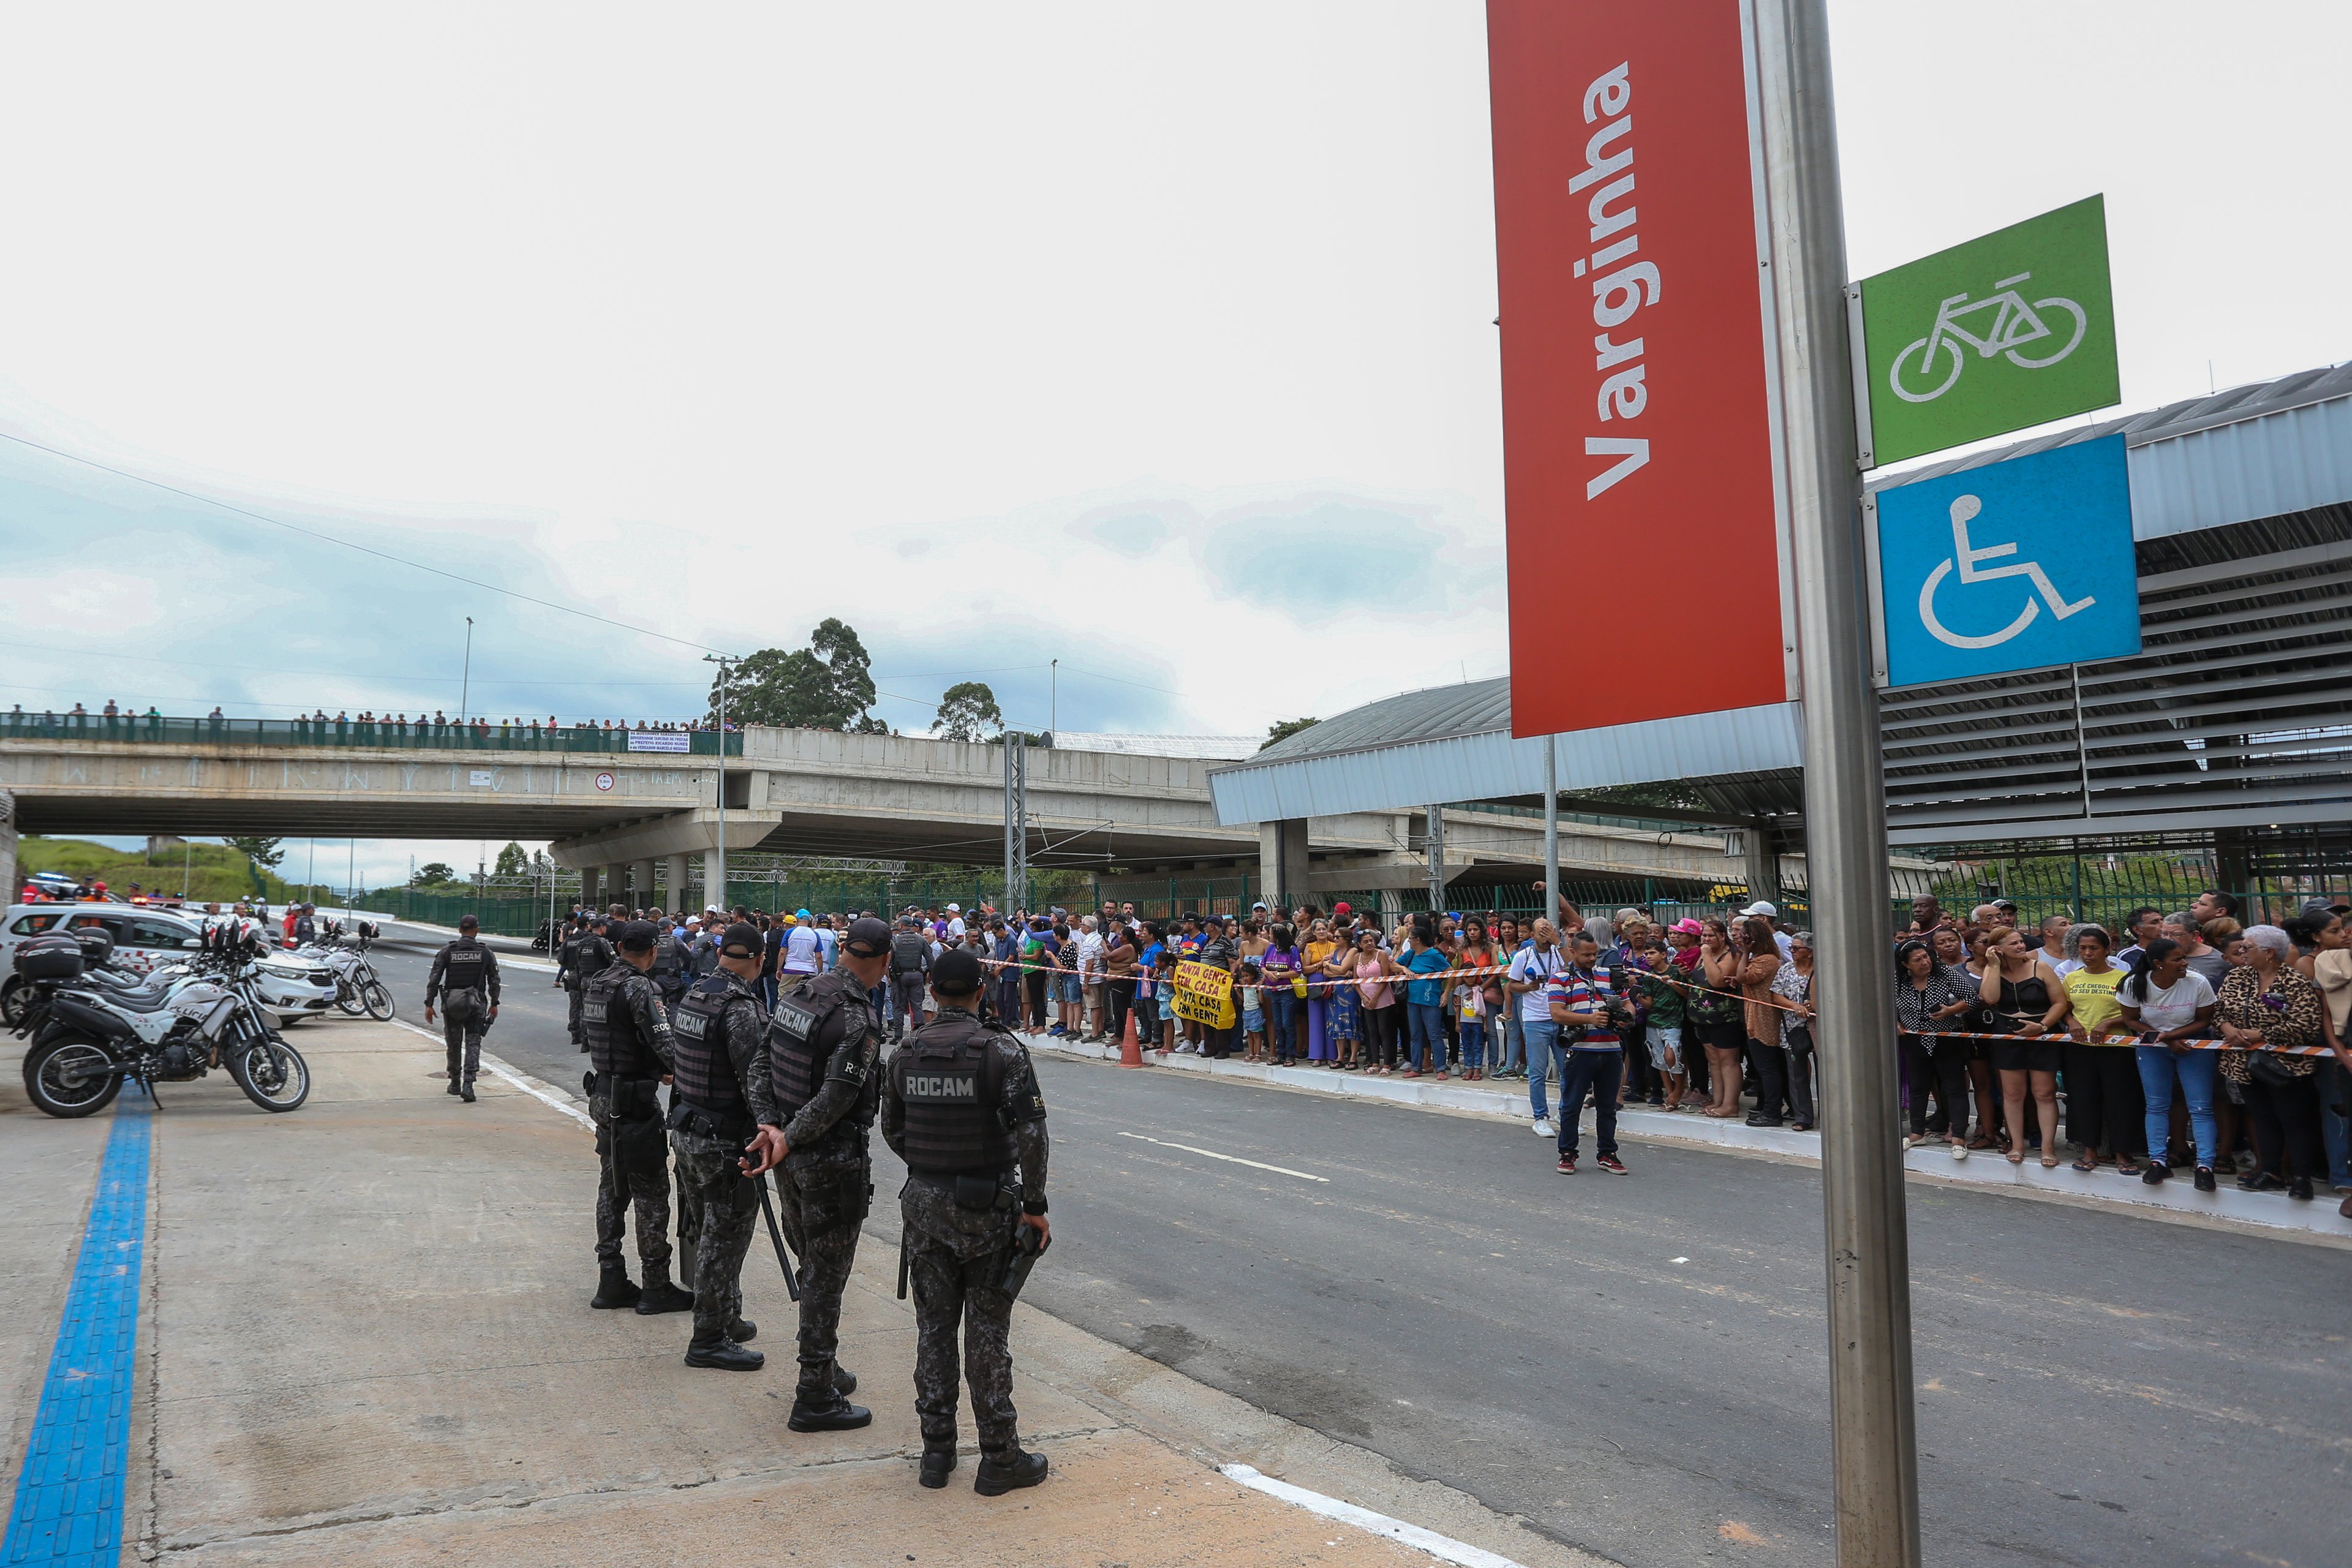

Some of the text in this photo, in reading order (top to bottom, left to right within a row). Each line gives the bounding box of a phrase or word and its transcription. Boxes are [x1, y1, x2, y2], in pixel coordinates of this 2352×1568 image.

[1569, 60, 1661, 502] Varginha
[1177, 975, 1219, 996] SEM CASA
[1203, 968, 1227, 984] GENTE
[584, 1003, 606, 1018] ROCAM
[1199, 996, 1221, 1012] CASA
[676, 1012, 706, 1035] ROCAM
[774, 1005, 812, 1035] ROCAM
[1194, 1008, 1218, 1025] GENTE
[906, 1076, 974, 1096] ROCAM
